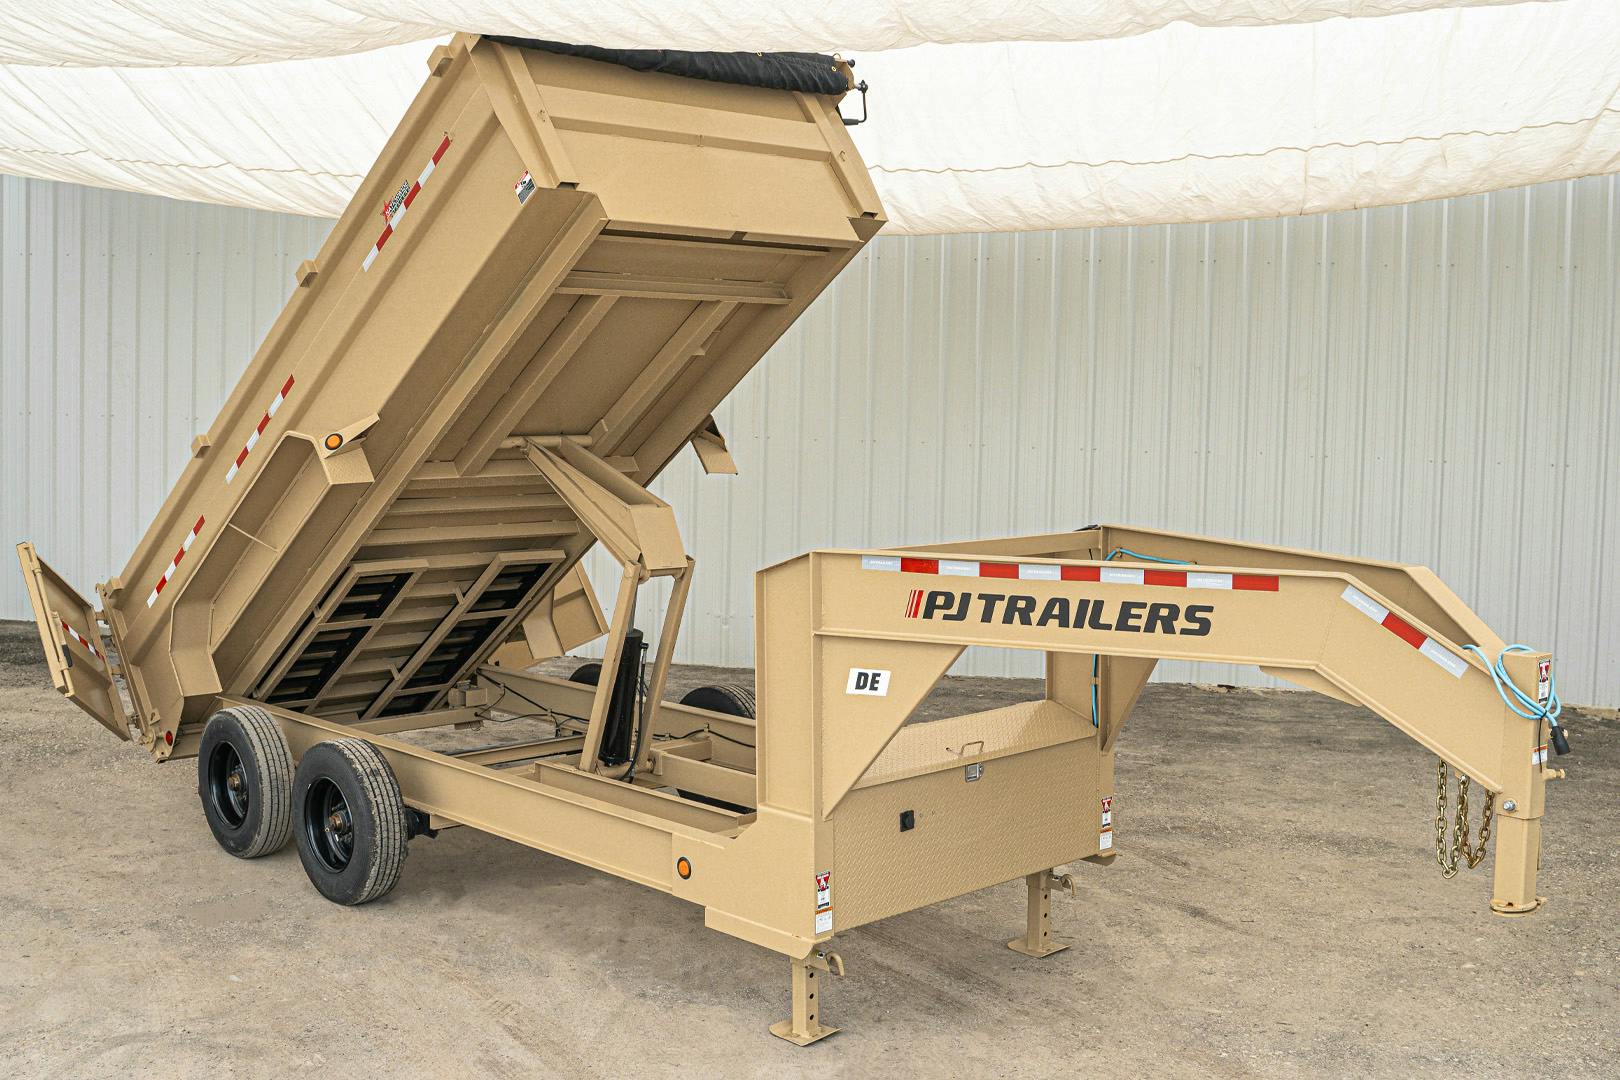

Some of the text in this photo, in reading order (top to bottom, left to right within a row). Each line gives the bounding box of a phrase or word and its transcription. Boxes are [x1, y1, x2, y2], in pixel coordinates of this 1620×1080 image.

[922, 590, 1214, 637] PJ TRAILERS
[855, 671, 881, 691] DE
